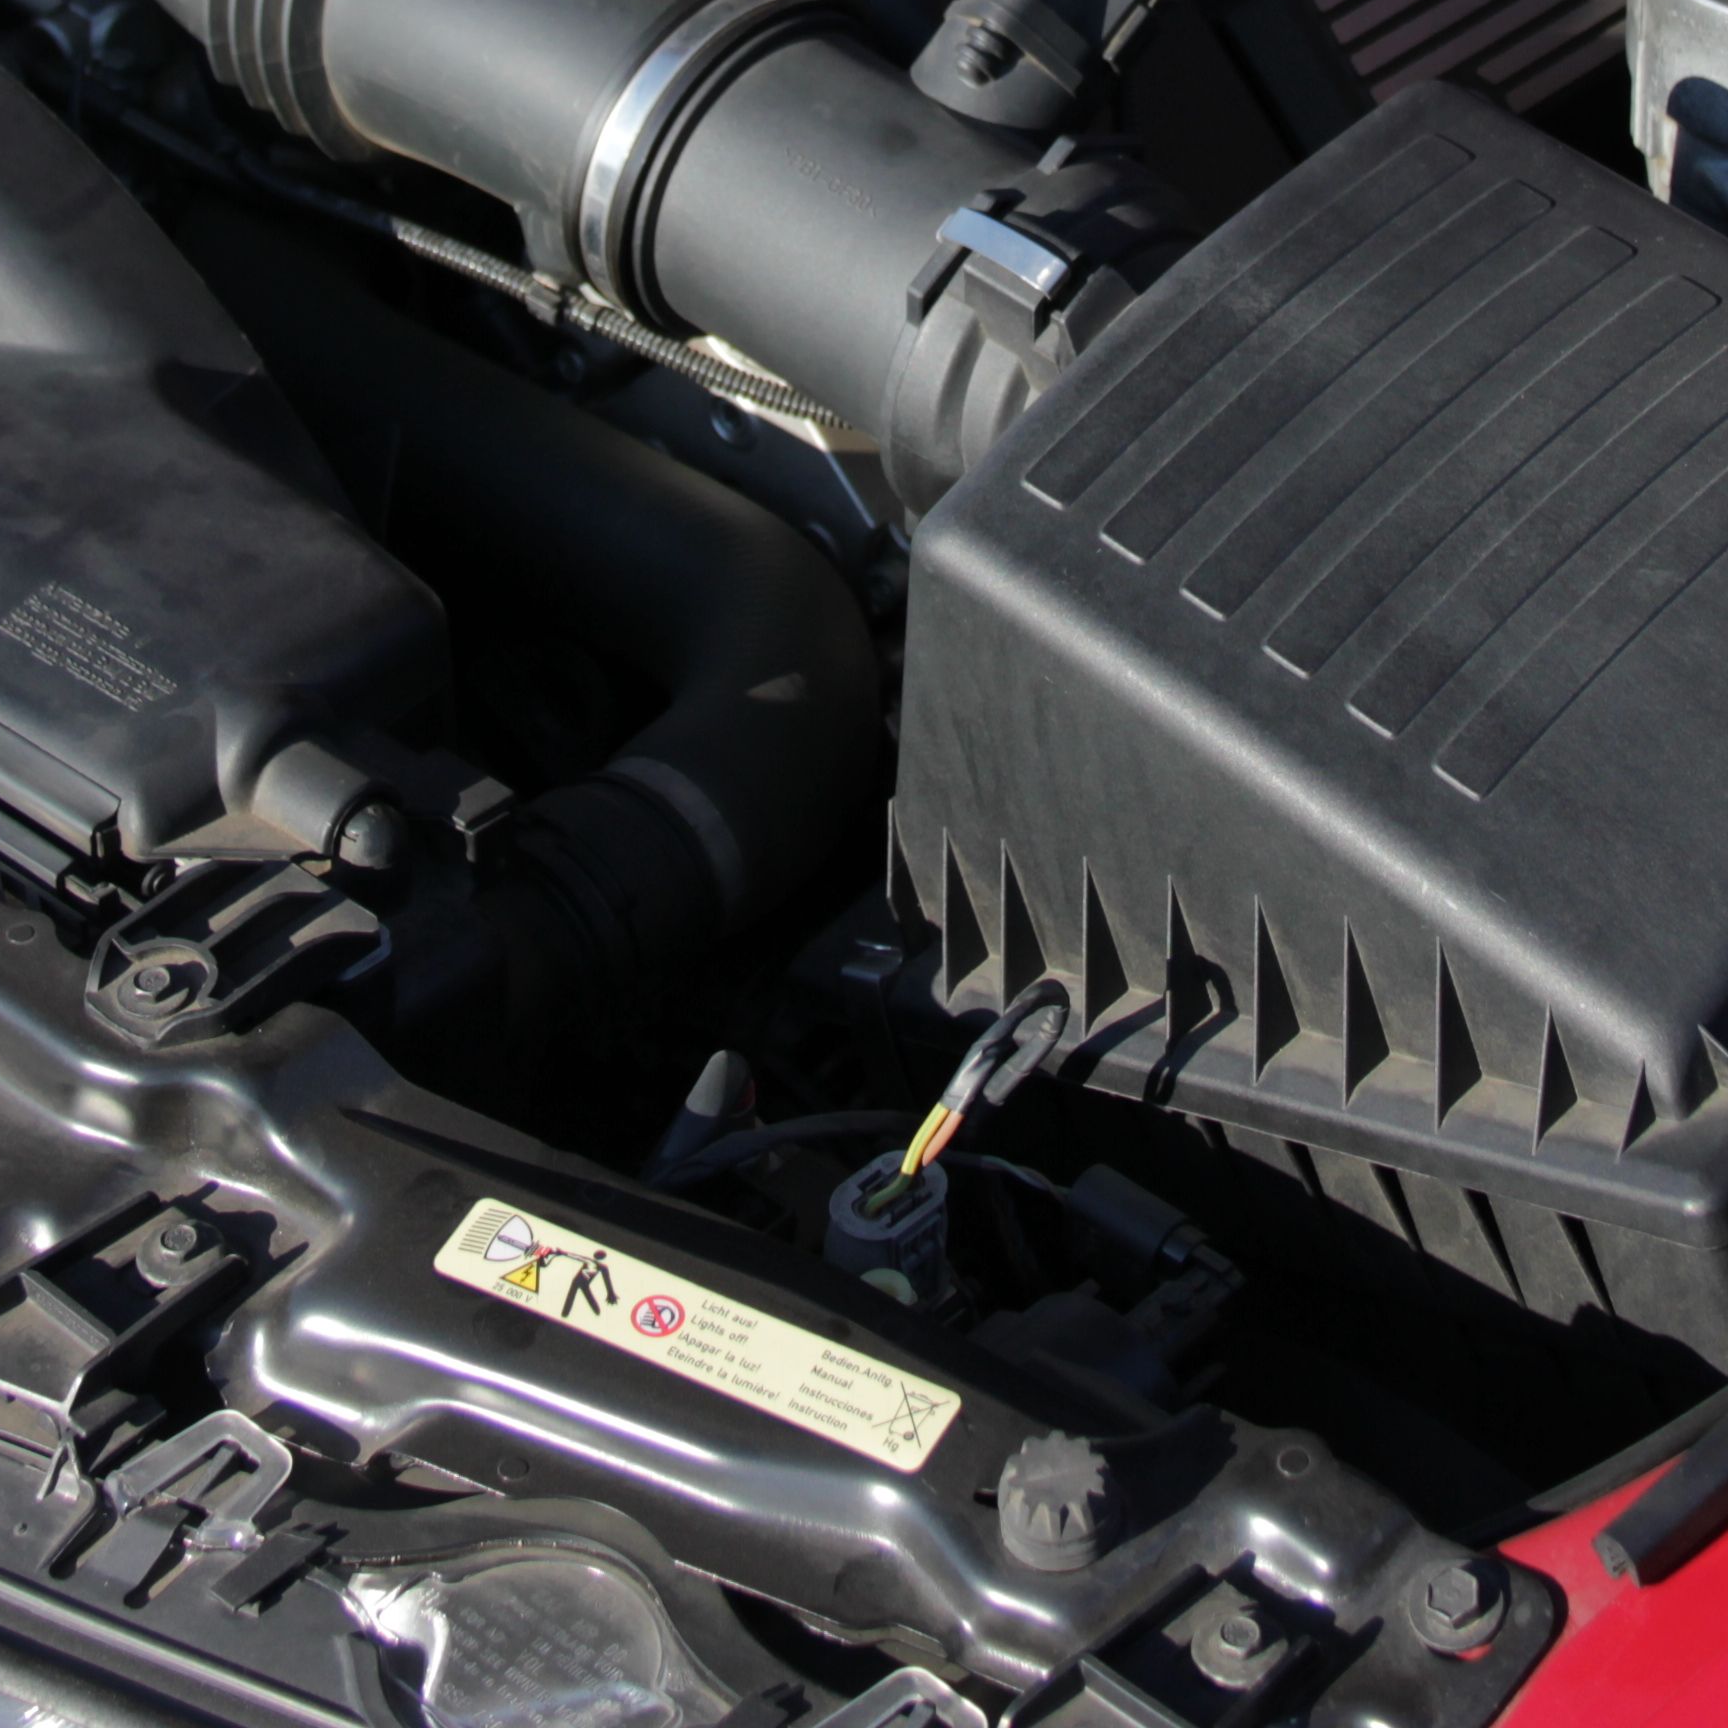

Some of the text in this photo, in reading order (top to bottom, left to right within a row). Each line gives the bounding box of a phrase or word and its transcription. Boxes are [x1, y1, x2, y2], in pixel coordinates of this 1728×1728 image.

[701, 1299, 760, 1329] Licht aus!
[690, 1315, 749, 1345] Lights off!
[666, 1346, 782, 1402] Eteindre la lumière!
[724, 1349, 736, 1363] la
[739, 1355, 762, 1372] luz!
[810, 1364, 855, 1390] Manual
[787, 1398, 849, 1432] Instruction
[798, 1381, 874, 1422] Instrucciones
[882, 1436, 900, 1454] Hg
